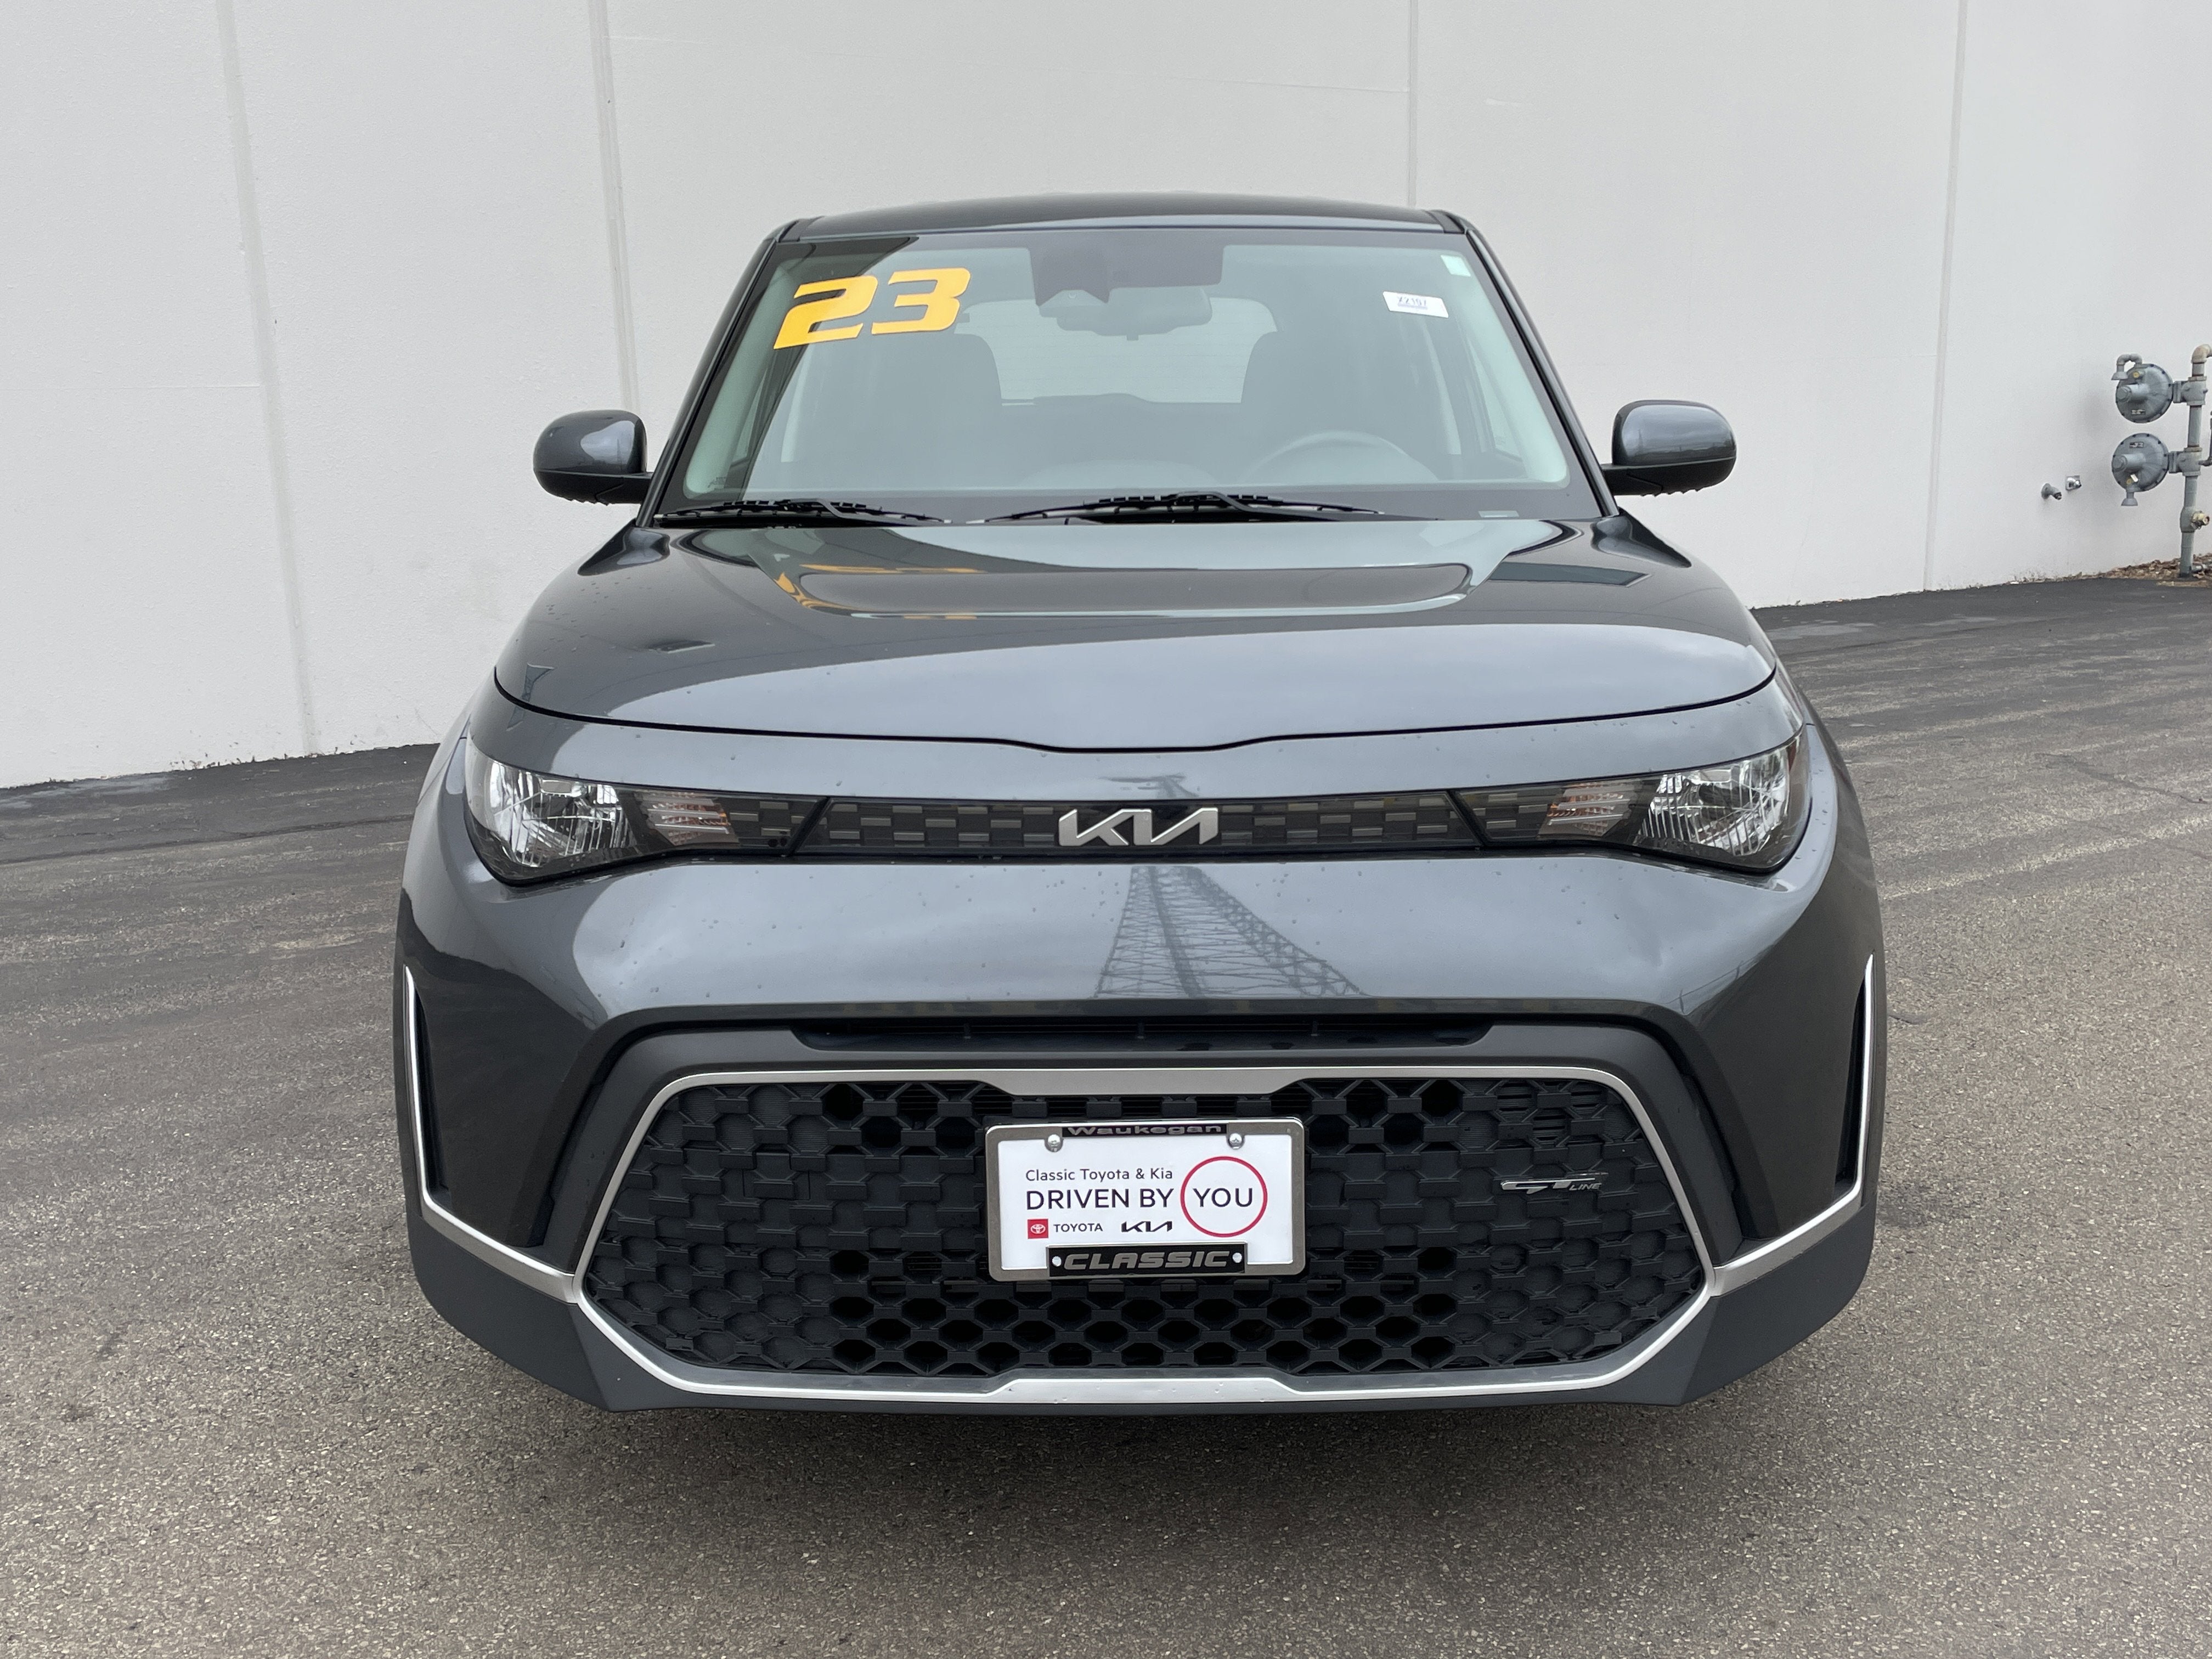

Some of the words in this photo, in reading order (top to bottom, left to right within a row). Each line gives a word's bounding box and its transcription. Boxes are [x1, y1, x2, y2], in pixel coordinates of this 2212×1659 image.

[773, 267, 971, 349] 23
[1059, 808, 1218, 846] KIA
[1068, 1125, 1222, 1136] Waukegan
[1025, 1169, 1075, 1182] Classic
[1080, 1168, 1130, 1183] Toyota
[1136, 1168, 1146, 1180] &
[1150, 1167, 1173, 1180] Kia
[1569, 1183, 1602, 1191] LINE
[1026, 1189, 1130, 1210] DRIVEN
[1139, 1188, 1174, 1208] BY
[1193, 1188, 1254, 1208] YOU
[1053, 1222, 1103, 1233] TOYOTA
[1121, 1220, 1173, 1233] KIA
[1063, 1250, 1230, 1270] CLASSIC
